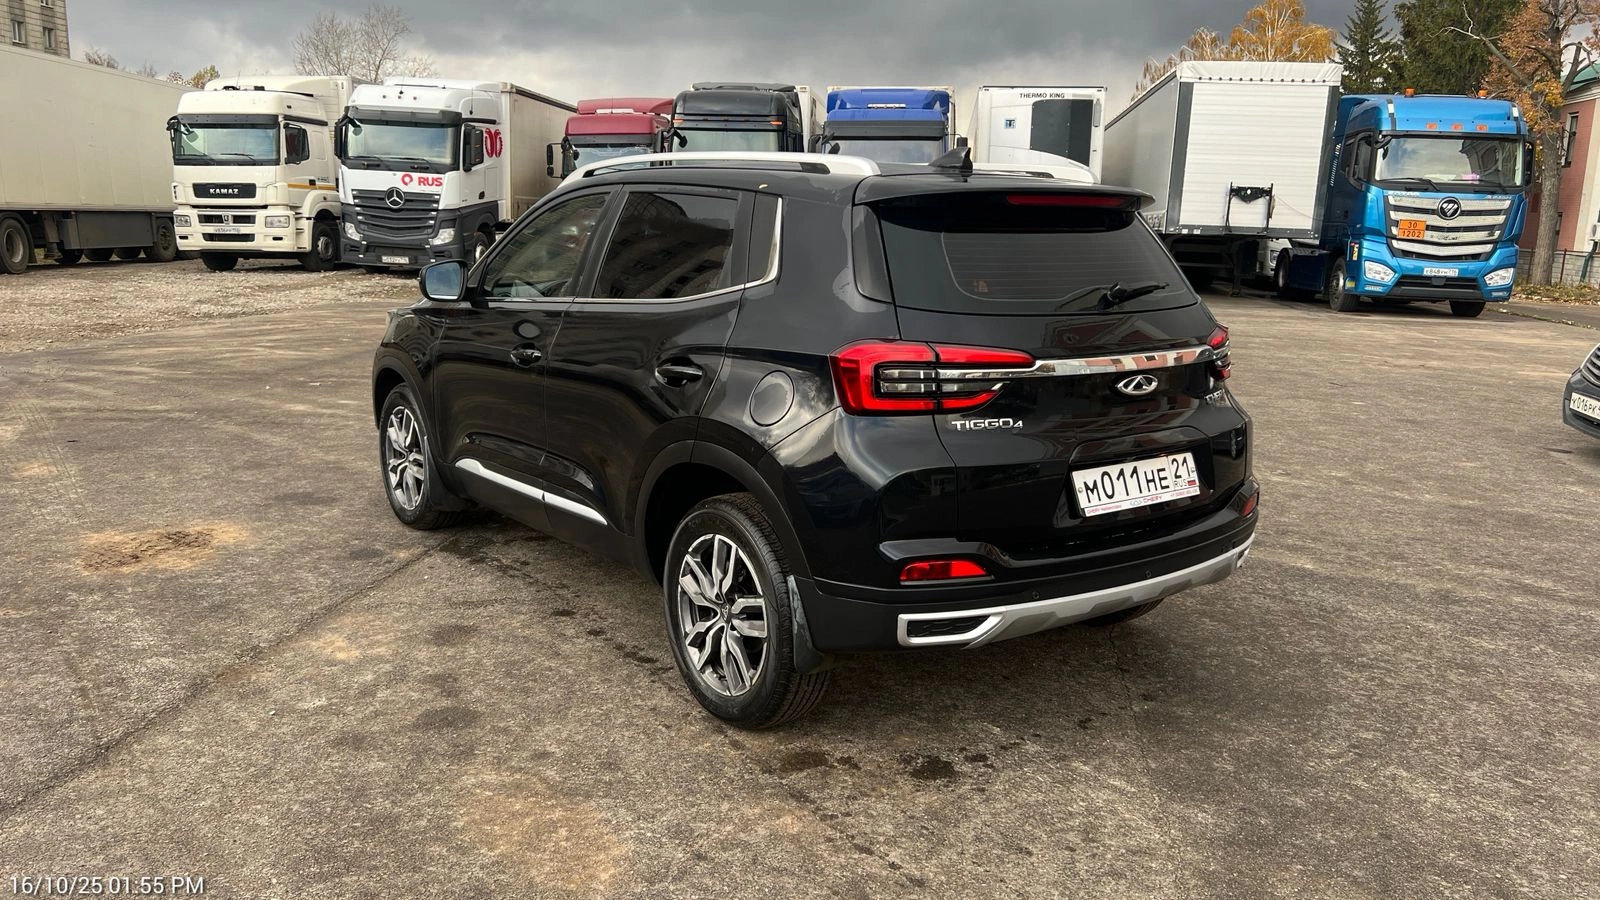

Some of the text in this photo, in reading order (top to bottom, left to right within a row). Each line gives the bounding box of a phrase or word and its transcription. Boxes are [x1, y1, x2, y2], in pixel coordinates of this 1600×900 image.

[417, 176, 443, 187] RUS
[1407, 221, 1418, 229] 30
[1401, 230, 1422, 238] 1202
[1171, 456, 1191, 479] 21
[1173, 478, 1188, 488] RUS
